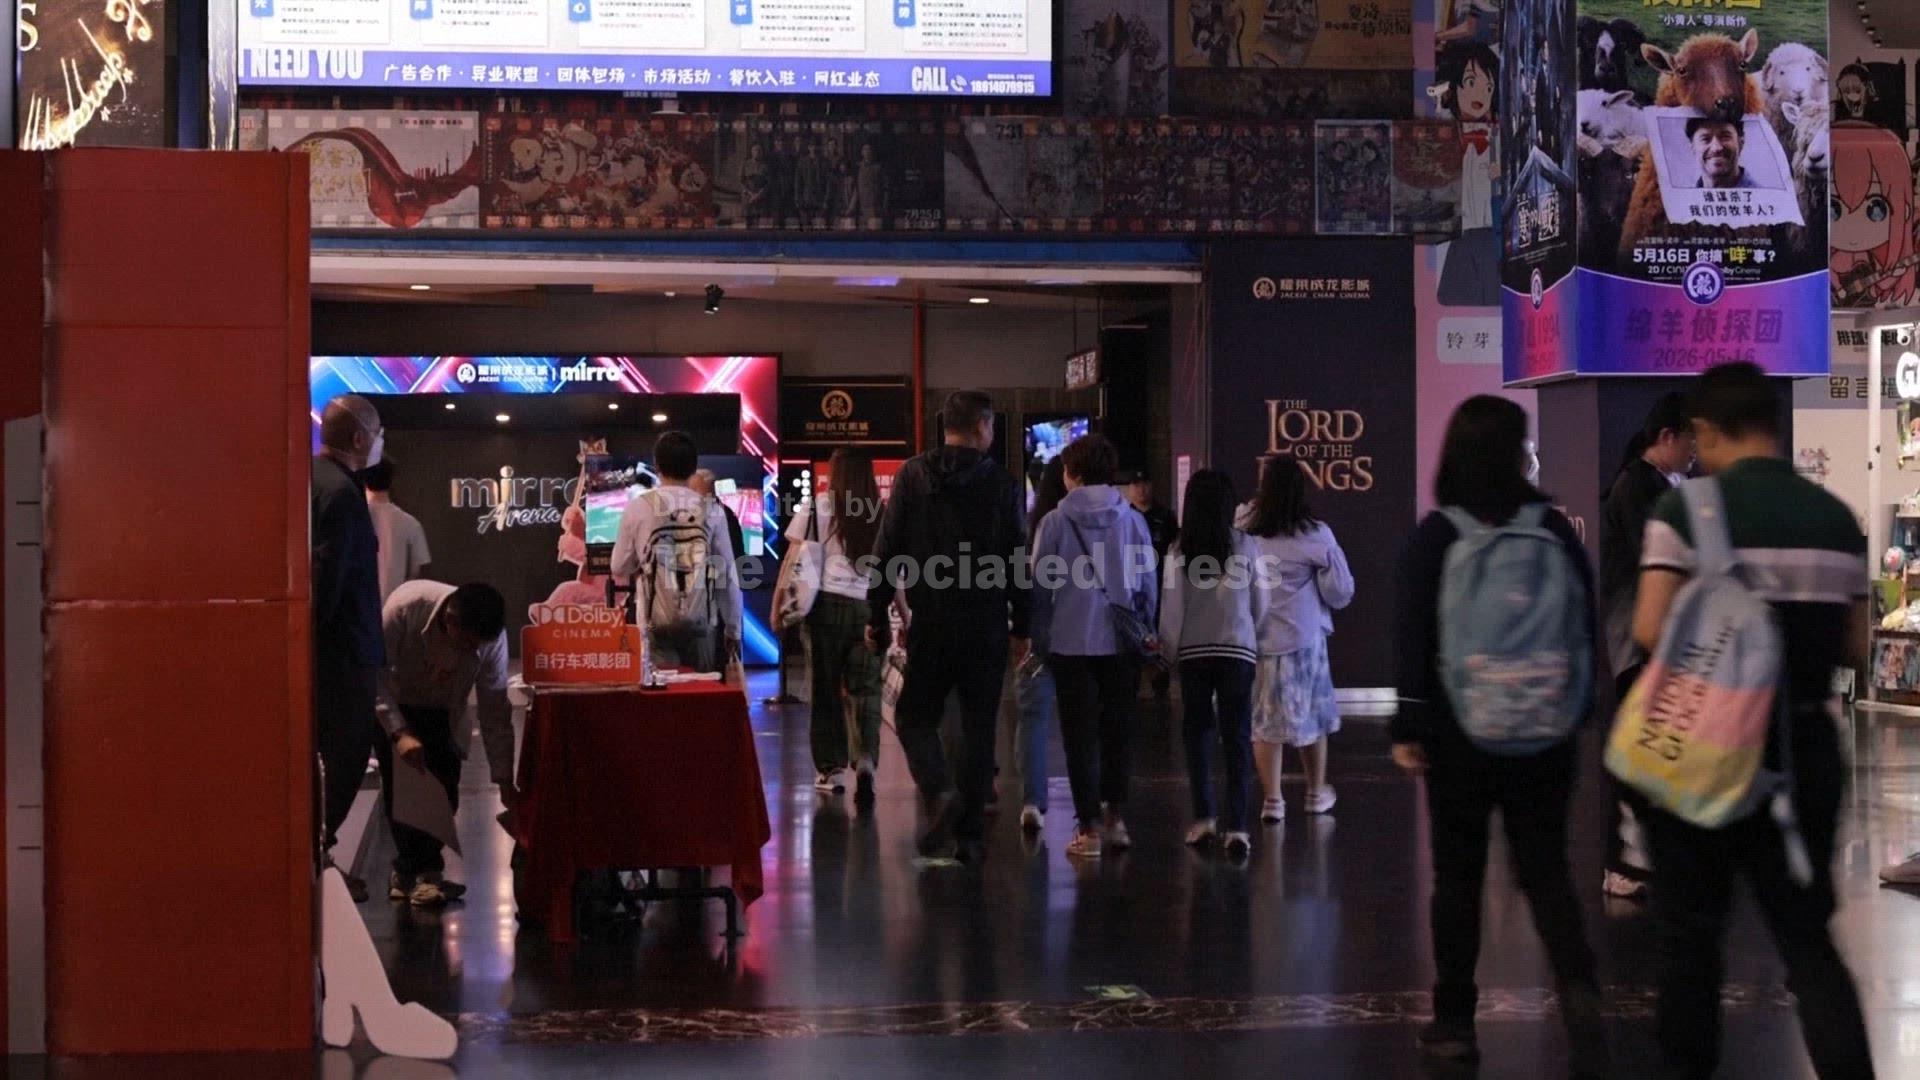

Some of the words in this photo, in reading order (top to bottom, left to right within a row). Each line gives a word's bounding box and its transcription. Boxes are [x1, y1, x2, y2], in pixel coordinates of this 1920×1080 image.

[251, 49, 310, 78] NEED
[316, 49, 364, 79] YOU
[384, 64, 452, 82] 广告合作
[472, 65, 538, 82] 异业联盟
[557, 67, 625, 84] 团体包场
[643, 68, 711, 85] 市场活动
[729, 68, 796, 86] 餐饮入驻
[814, 70, 880, 88] 网红业态
[912, 66, 948, 92] CALL
[1633, 248, 1690, 263] 5月16日
[1624, 309, 1783, 343] 绵羊侦探团
[560, 363, 621, 381] mirro
[1283, 400, 1308, 409] THE
[1264, 399, 1364, 454] LORD
[1295, 444, 1317, 458] OF
[1320, 444, 1353, 458] THE
[1256, 456, 1374, 492] NGS
[477, 502, 561, 534] Arena
[567, 605, 622, 628] Dolby
[553, 629, 611, 638] CINEMA
[535, 652, 632, 669] 自行车观影团
